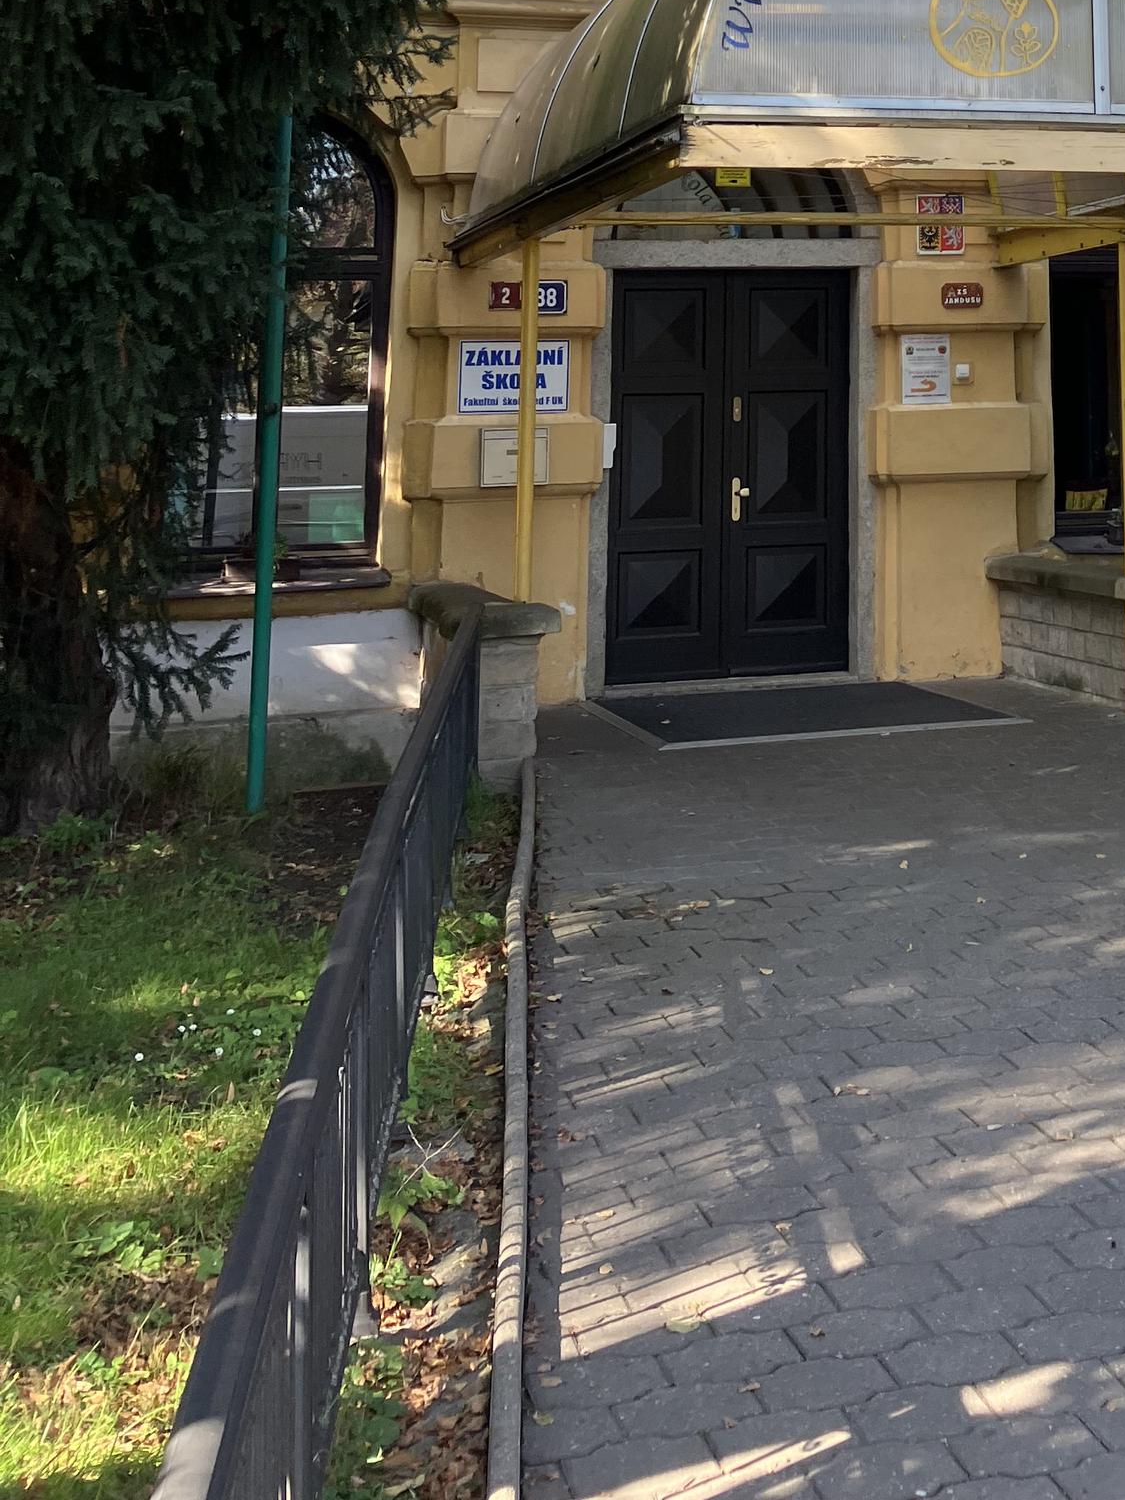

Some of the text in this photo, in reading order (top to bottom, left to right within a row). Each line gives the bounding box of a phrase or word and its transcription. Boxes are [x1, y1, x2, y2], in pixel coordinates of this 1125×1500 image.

[501, 287, 511, 304] 2
[465, 347, 563, 366] ZÁKLNÍ
[481, 371, 547, 389] ŠKOA
